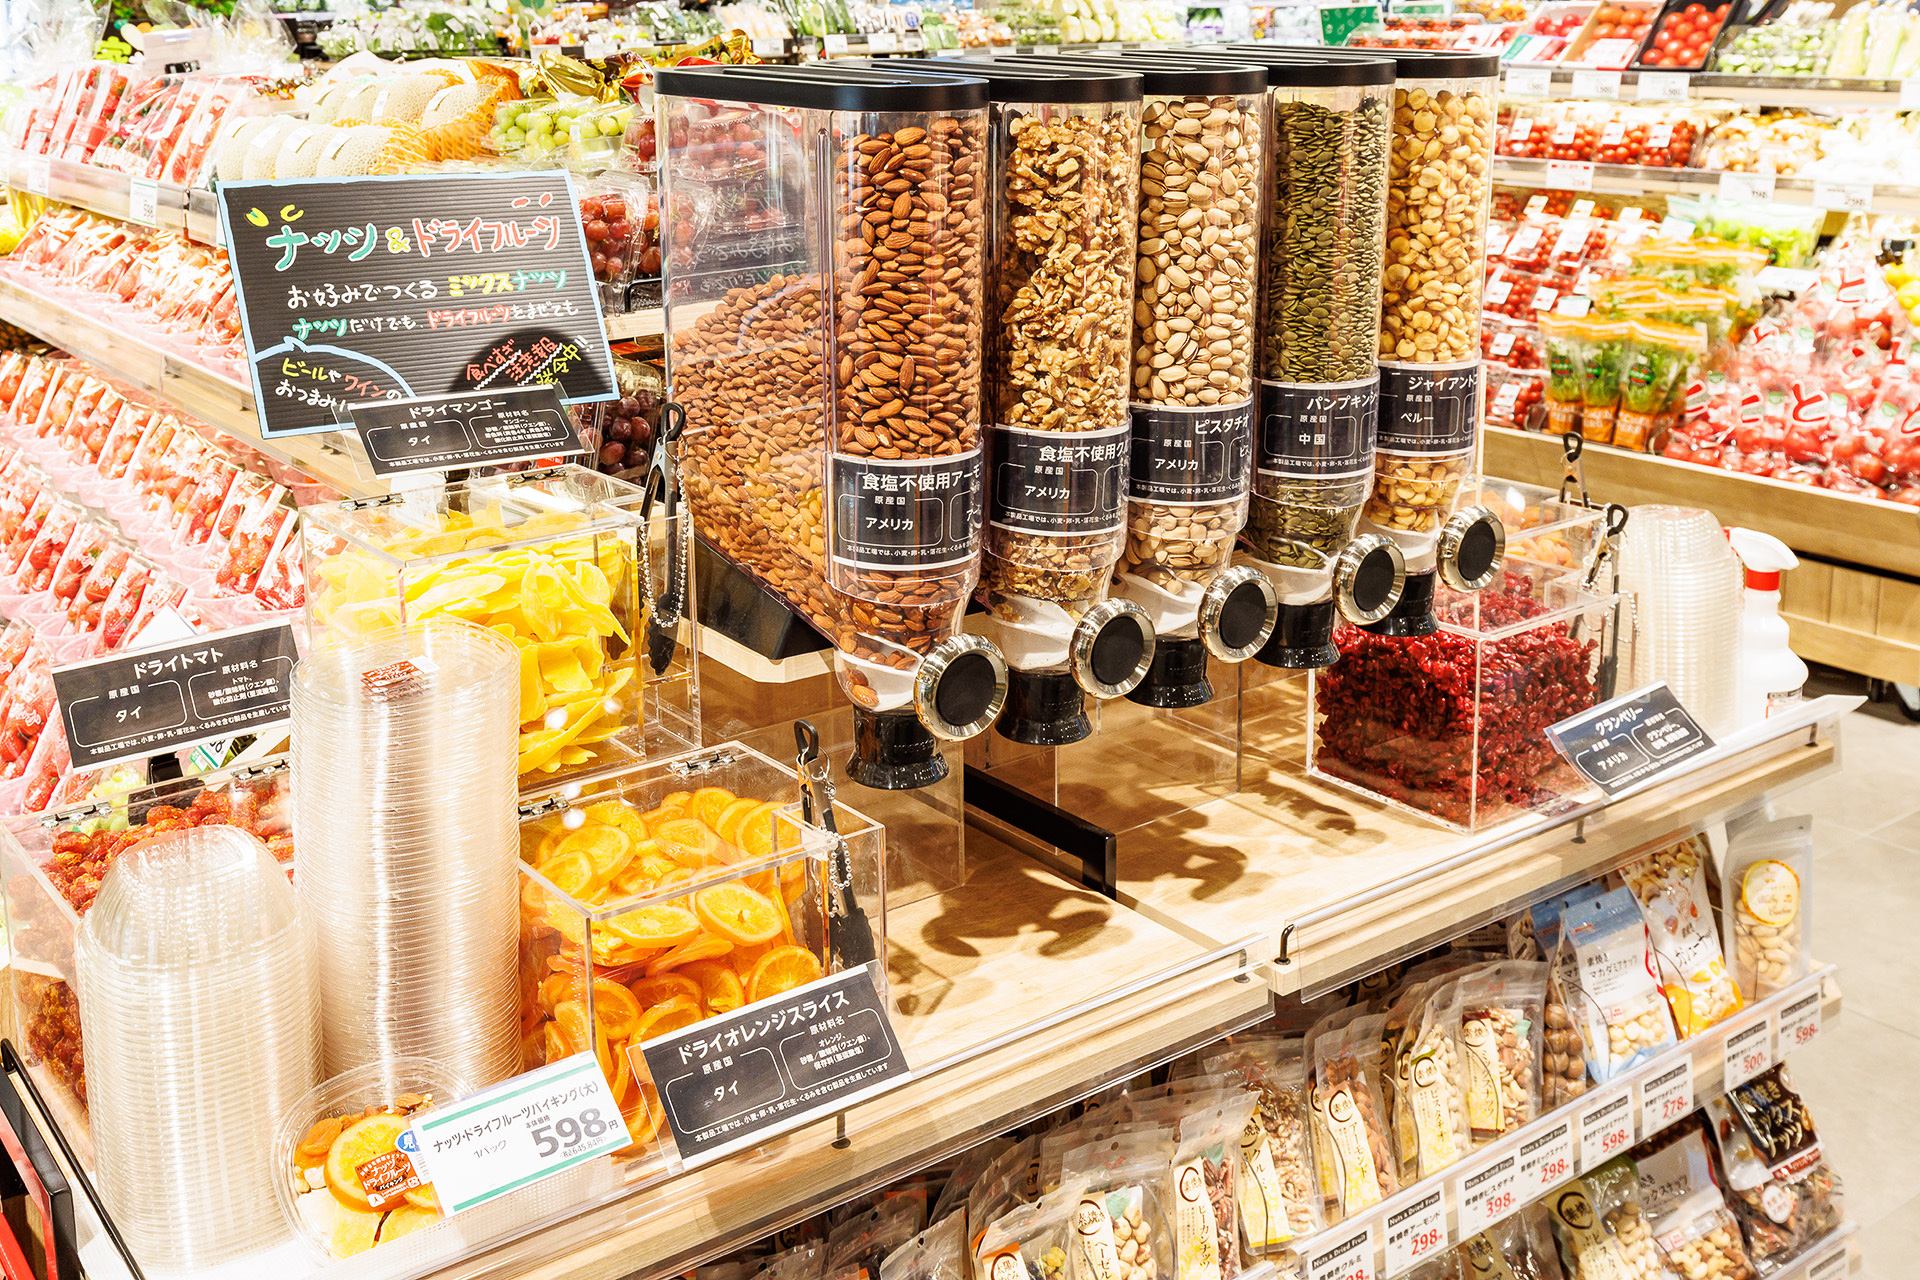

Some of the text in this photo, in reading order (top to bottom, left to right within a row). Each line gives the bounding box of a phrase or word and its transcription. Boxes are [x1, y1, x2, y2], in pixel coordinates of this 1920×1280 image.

[265, 216, 560, 271] ナッツ & ドライフルーツ
[287, 269, 568, 309] お好みでつくる ミックスナッツ
[409, 398, 507, 420] ドライマンゴー
[1400, 412, 1434, 423] ペルー
[408, 435, 431, 447] タイ
[1299, 433, 1326, 445] 中国
[1154, 458, 1198, 471] アメリカ
[874, 496, 906, 505] 原産国
[1024, 485, 1070, 499] アメリカ
[865, 517, 914, 531] アメリカ
[133, 647, 224, 680] ドライトマト
[108, 659, 258, 700] 原産国 原材料名
[115, 705, 142, 723] タイ
[1595, 707, 1643, 736] クランベリー
[1597, 752, 1629, 770] アメリカ
[677, 990, 850, 1066] ドライオレンジスライス
[703, 1015, 845, 1075] 原産国 原材料名
[714, 1080, 739, 1102] タイ
[363, 1162, 411, 1191] ドライフルーツ
[371, 1158, 395, 1177] ナッツ
